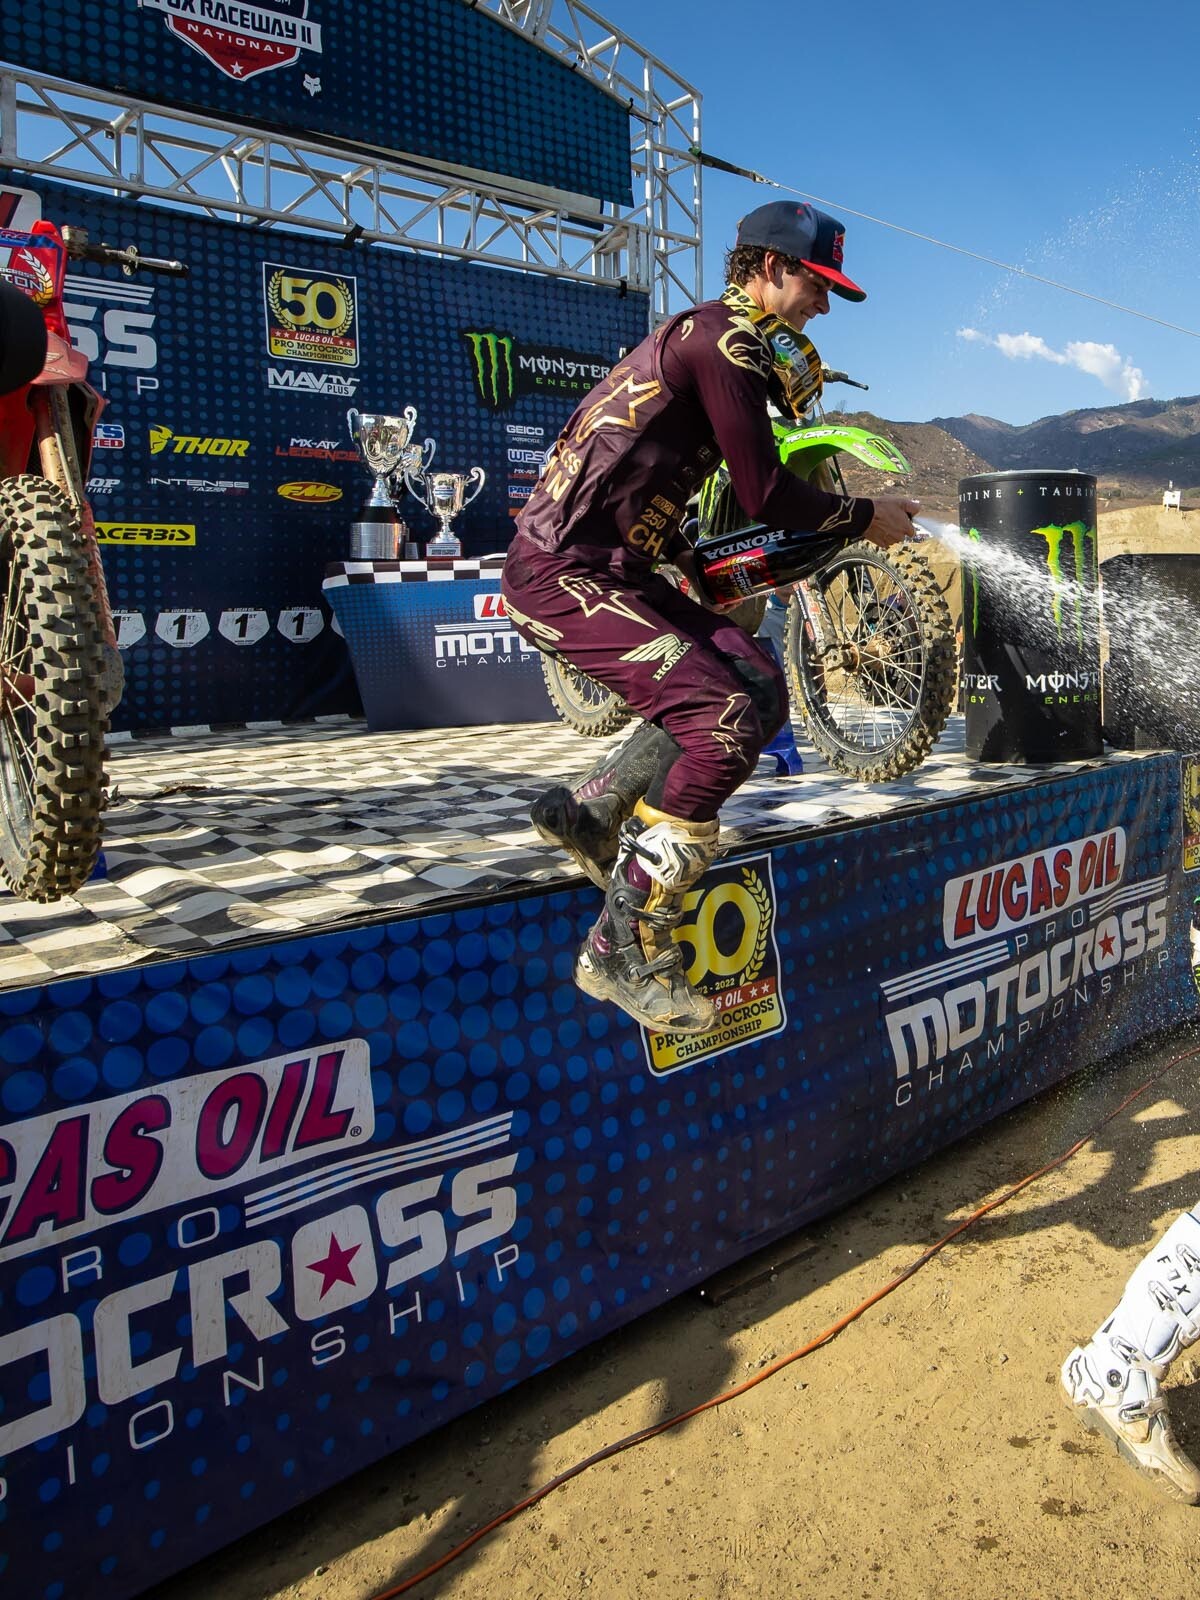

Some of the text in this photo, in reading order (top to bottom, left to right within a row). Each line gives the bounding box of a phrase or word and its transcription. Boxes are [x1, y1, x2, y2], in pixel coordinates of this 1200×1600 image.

[148, 0, 196, 14] OX
[201, 0, 296, 39] RACEWAY
[188, 23, 285, 55] NATIONAL
[281, 276, 346, 329] 50
[274, 339, 353, 357] PRO MOTOCROSS
[294, 332, 334, 345] LUCAS OIL
[286, 348, 344, 361] CHAMPIONSHIP
[518, 355, 609, 379] MONSTER
[327, 384, 350, 396] PLUS
[506, 424, 544, 436] GEICO
[172, 435, 250, 457] THOR
[508, 448, 546, 465] WPS
[151, 477, 249, 489] INTENSE
[278, 485, 343, 498] FMF
[641, 508, 667, 530] 250
[703, 530, 786, 560] HONDA
[653, 641, 692, 681] HONDA
[953, 831, 1121, 940] LUCAS OIL
[1015, 908, 1086, 956] PRO
[715, 978, 735, 990] 2022
[885, 897, 1168, 1079] MOTOCROSS
[725, 990, 744, 1007] OIL
[676, 1019, 762, 1058] CHAMPIONSHIP
[896, 950, 1169, 1107] CHAMPIONSHIP
[196, 1049, 355, 1181] OIL
[0, 1244, 520, 1500] IONSHIP
